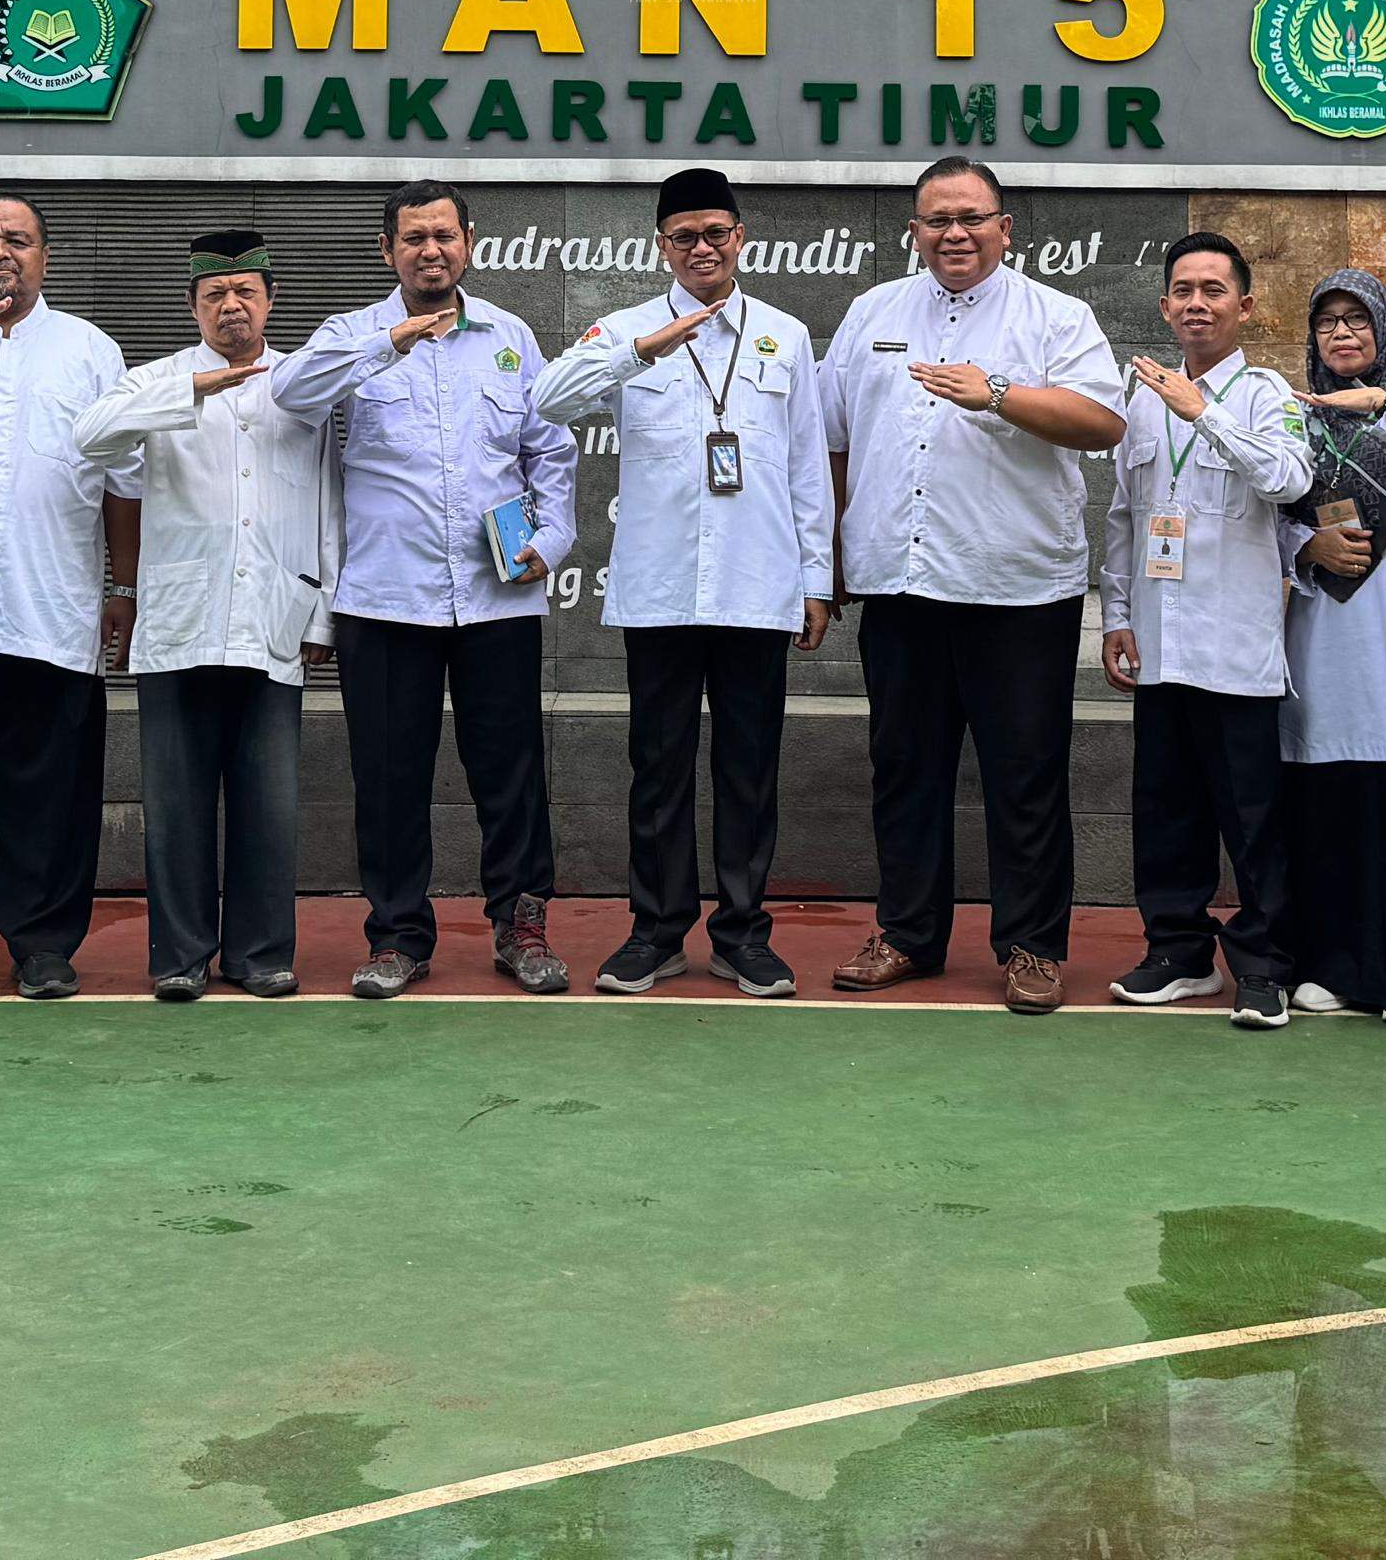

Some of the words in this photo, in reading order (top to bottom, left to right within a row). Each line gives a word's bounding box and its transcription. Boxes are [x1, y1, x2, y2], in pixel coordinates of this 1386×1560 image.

[1270, 4, 1303, 98] MADRASAH
[15, 69, 42, 87] IKHLAS
[45, 70, 85, 87] BERAMAL
[236, 77, 756, 146] JAKARTA
[802, 84, 1163, 149] TIMUR
[1319, 107, 1347, 118] IKHLAS
[1349, 107, 1385, 119] BERAMAL
[470, 222, 673, 273] adrasa
